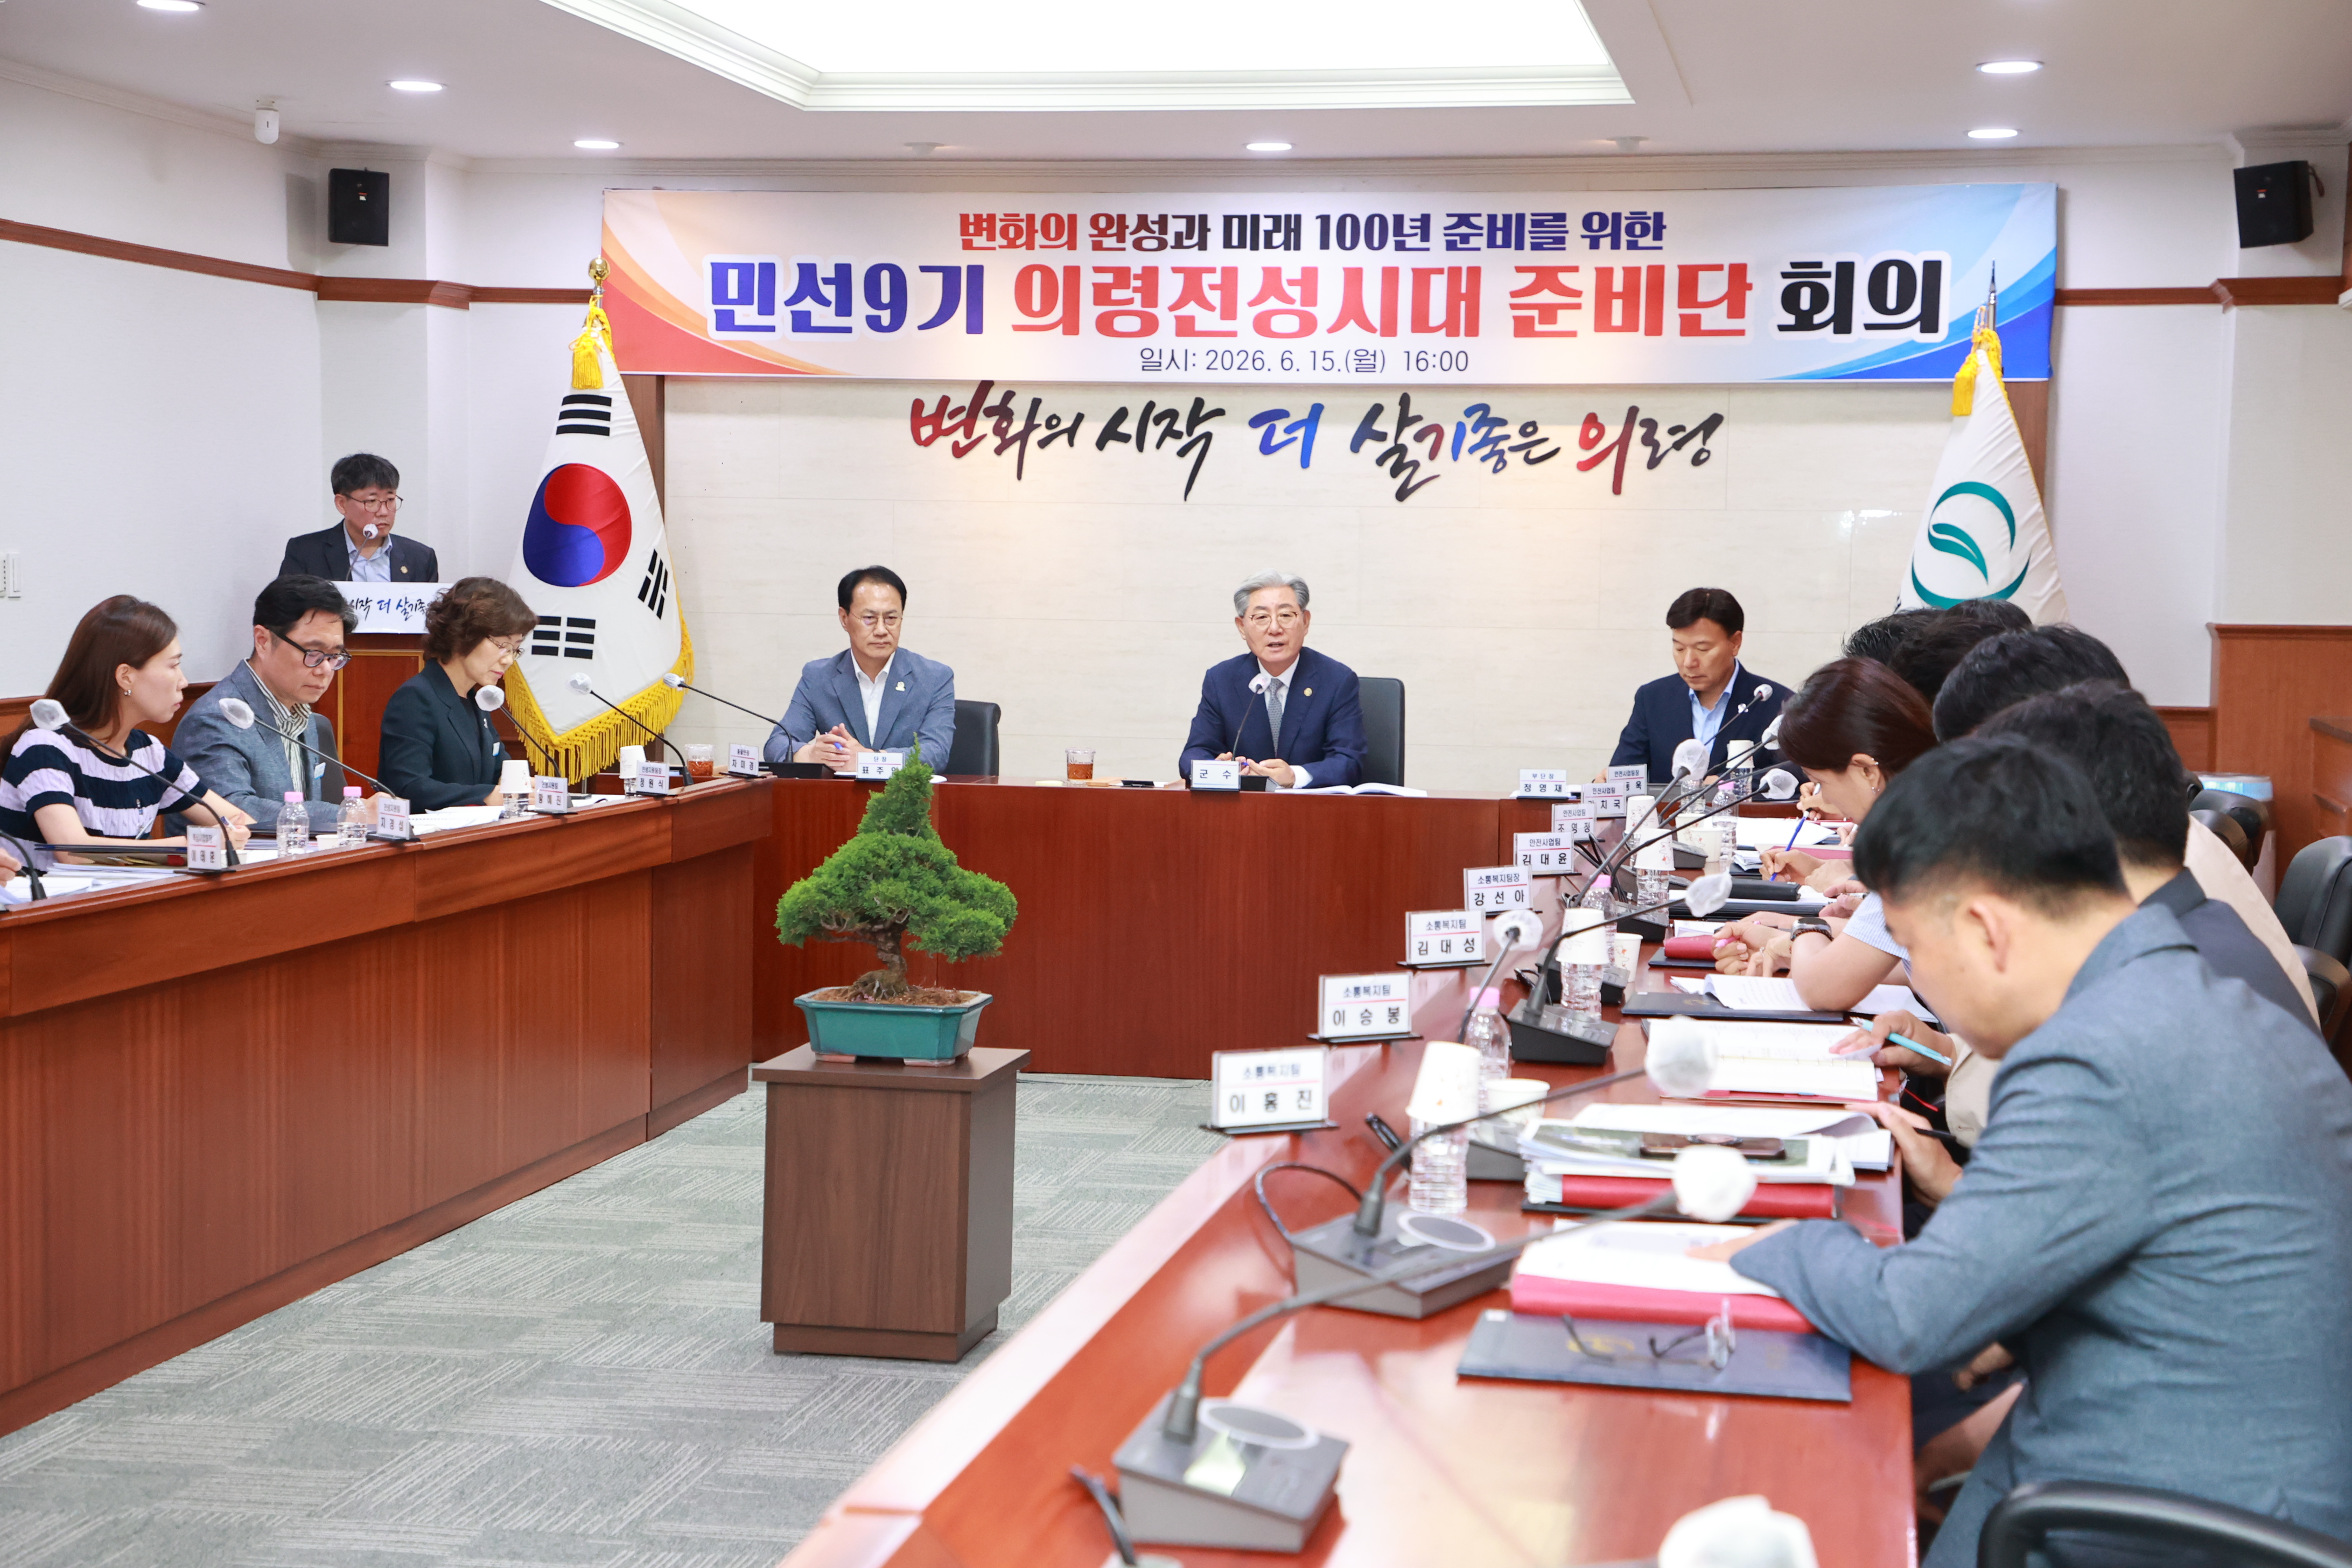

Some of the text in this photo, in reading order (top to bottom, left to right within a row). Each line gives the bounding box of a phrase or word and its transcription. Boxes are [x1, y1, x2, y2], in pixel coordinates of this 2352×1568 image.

[959, 211, 1667, 252] 변화의 완성과 미래 100년 준비를 위한
[710, 260, 1942, 339] 민선9기 의령전성시대 준비단 회의
[1140, 347, 1468, 373] 일시: 2026. 6. 15.(월) 16:00
[910, 380, 1084, 480] 변화의
[1095, 396, 1226, 502] 시작
[1248, 402, 1325, 469] 더
[1576, 405, 1724, 495] 의령
[377, 598, 391, 614] 더
[1529, 838, 1561, 847] 안전사업팀
[1478, 873, 1520, 884] 소통복지팀장
[1426, 919, 1466, 931] 소통복지팀
